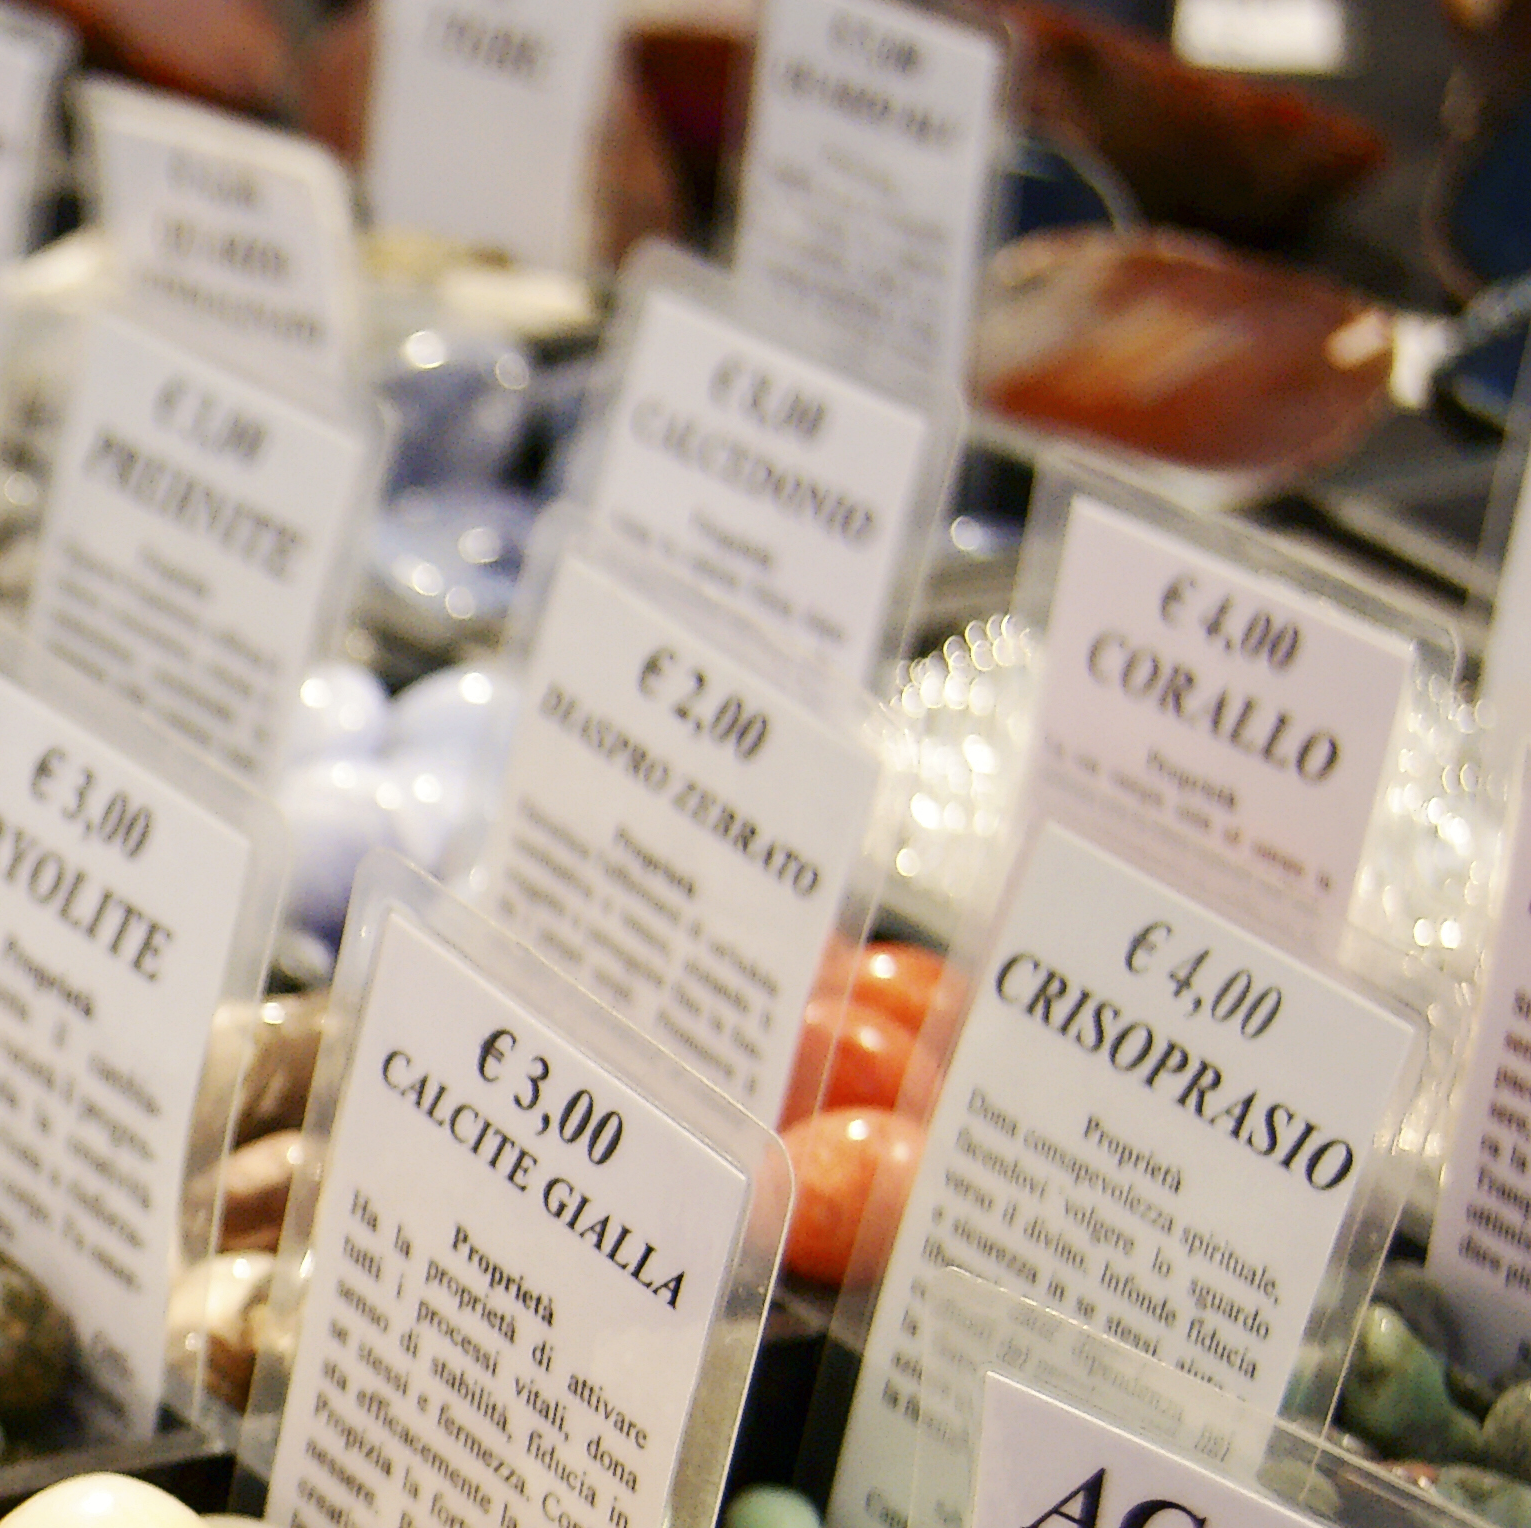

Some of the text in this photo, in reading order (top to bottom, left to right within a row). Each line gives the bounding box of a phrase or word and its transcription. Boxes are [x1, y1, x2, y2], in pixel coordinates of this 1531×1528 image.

[1158, 576, 1196, 624] €
[637, 646, 770, 762] € 2,00
[1086, 634, 1342, 785] CORALLO
[29, 746, 154, 861] € 3,00
[538, 682, 822, 899] DIASPRO ZEBRATO
[1123, 920, 1283, 1040] € 4,00
[476, 1027, 624, 1167] € 3,00
[994, 953, 1354, 1192] CRISOPRASIO
[380, 1048, 686, 1311] CALCITE GIALLA
[965, 1087, 1280, 1307] Dona spirituale,
[1082, 1114, 1182, 1196] Proprietà
[349, 1188, 648, 1450] Ha la proprietà di attivare
[450, 1224, 555, 1328] Proprietà
[1001, 1202, 1018, 1228] il
[1099, 1260, 1177, 1328] Infonde
[1185, 1316, 1258, 1382] fiducia
[1063, 1197, 1271, 1341] volgere lo sguardo
[322, 1361, 348, 1393] sta
[354, 1388, 492, 1515] efficacemente
[329, 1320, 349, 1346] se
[356, 1342, 409, 1398] stessi
[415, 1393, 429, 1413] e
[435, 1402, 530, 1502] fermezza.
[336, 1279, 390, 1334] senso
[398, 1327, 420, 1360] di
[430, 1356, 513, 1443] stabilità,
[525, 1428, 597, 1509] fiducia
[342, 1234, 638, 1494] tutti i processi vitali, dona
[312, 1390, 393, 1479] Propizia
[401, 1465, 420, 1502] la
